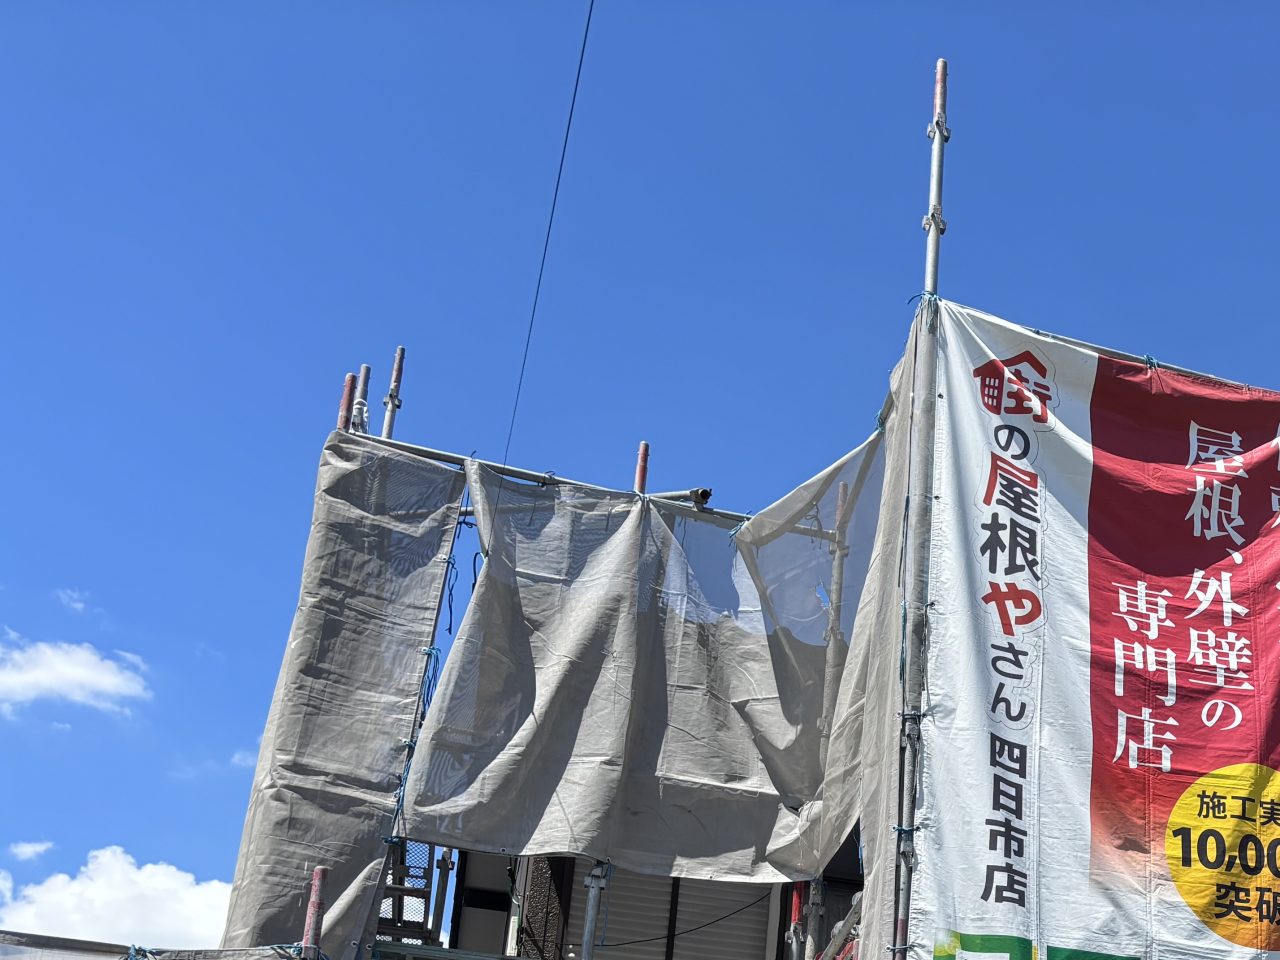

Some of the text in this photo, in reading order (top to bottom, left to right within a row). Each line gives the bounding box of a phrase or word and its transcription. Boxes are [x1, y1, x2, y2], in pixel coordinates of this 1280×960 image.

[1111, 580, 1177, 772] 専門店
[1184, 420, 1255, 731] 屋根、外壁の
